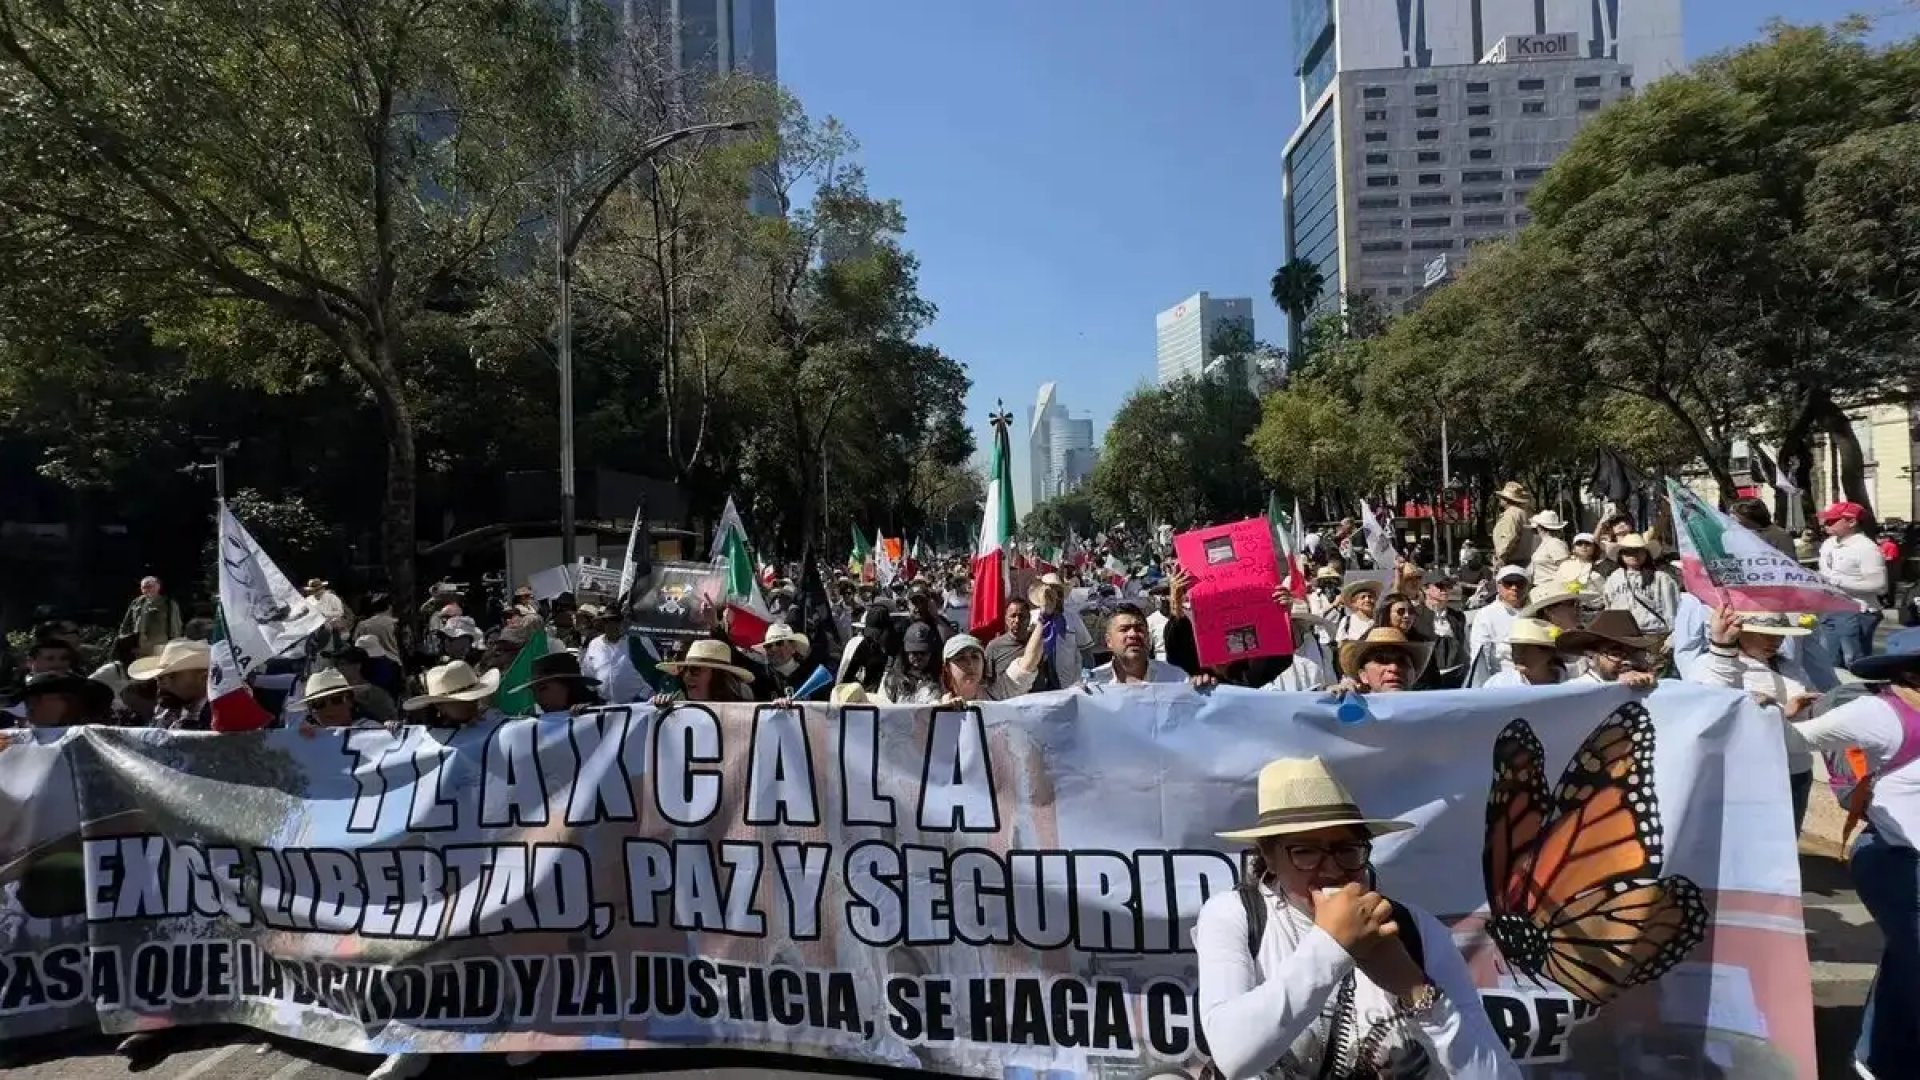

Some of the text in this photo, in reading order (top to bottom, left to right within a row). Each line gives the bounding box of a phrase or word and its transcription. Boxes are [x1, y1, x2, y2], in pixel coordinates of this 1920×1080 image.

[1517, 35, 1567, 54] Knoll
[341, 704, 999, 833] TLAXCALA
[254, 841, 611, 941] LIBERTAD,
[623, 838, 766, 937] PAZ
[773, 842, 831, 941] Y
[842, 841, 1256, 954] SEGURID
[133, 942, 233, 1007] QUE
[239, 941, 284, 1001] LA
[510, 956, 553, 1017] Y
[555, 954, 620, 1017] LA
[627, 954, 875, 1041] JUSTICIA,
[888, 976, 956, 1043] SE
[968, 976, 1135, 1053] HAGA
